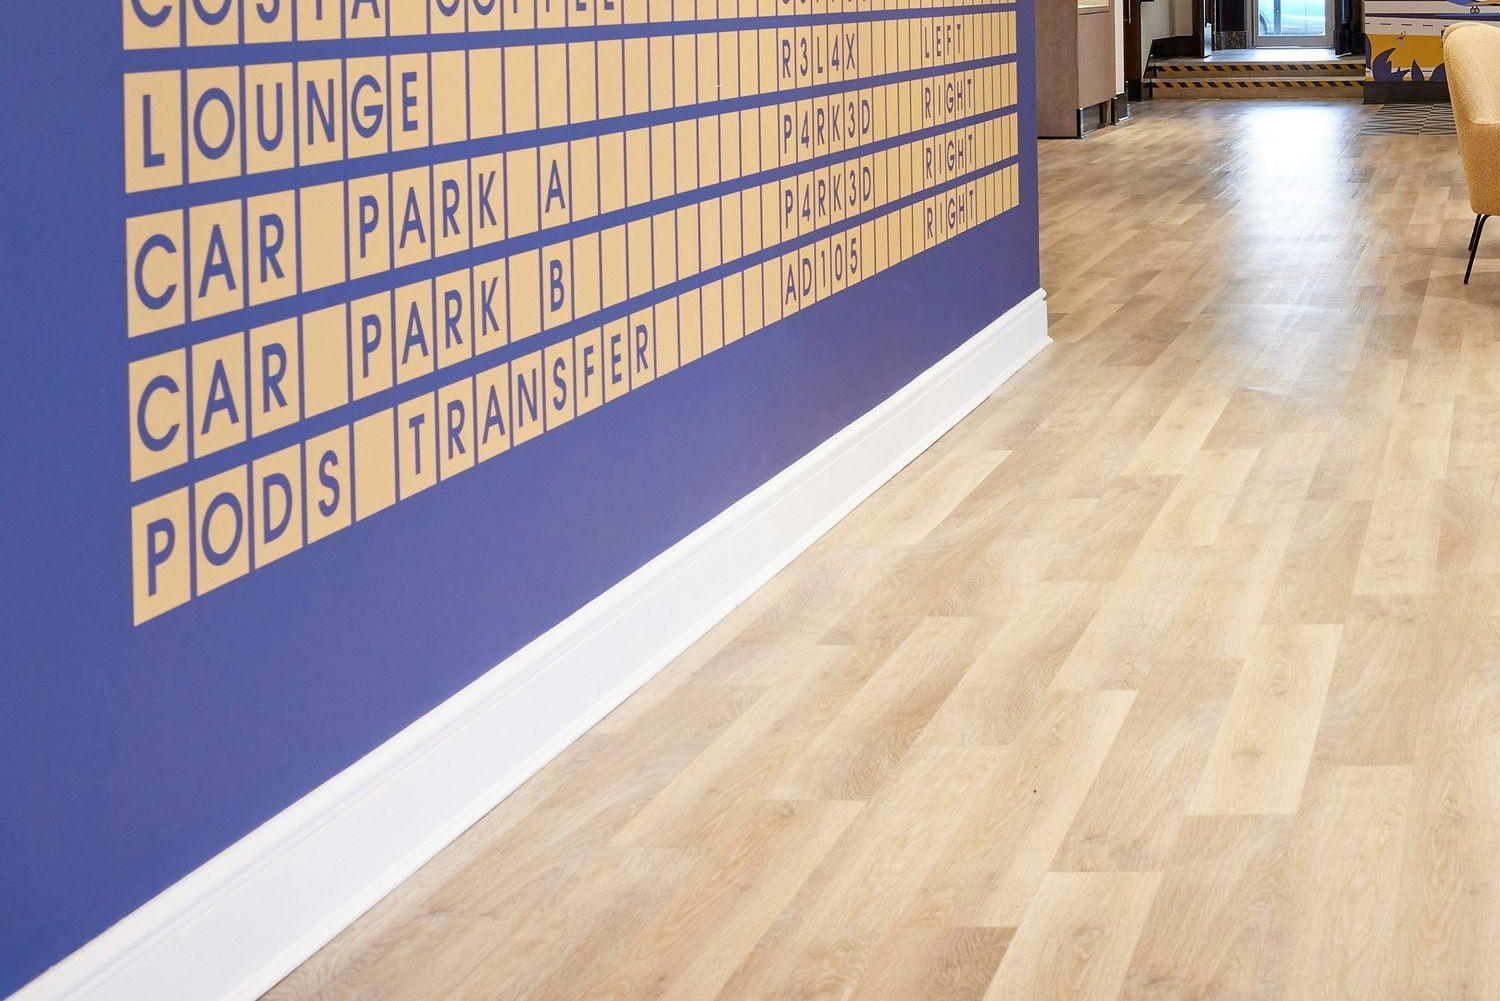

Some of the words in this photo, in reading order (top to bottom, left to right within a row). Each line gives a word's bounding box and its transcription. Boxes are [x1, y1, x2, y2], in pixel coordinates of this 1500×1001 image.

[133, 212, 285, 311] CAR
[359, 171, 497, 259] PARK
[544, 160, 566, 213] A
[784, 99, 871, 154] P4RK3D
[925, 78, 972, 119] RIGHT
[141, 71, 419, 168] LOUNGE
[782, 33, 856, 78] R3L4X
[925, 23, 962, 58] LEFT
[136, 342, 288, 453] CAR
[360, 276, 500, 379] PARK
[548, 259, 565, 312] B
[785, 166, 872, 229] P4RK3D
[926, 134, 973, 179] RIGHT
[145, 449, 341, 597] PODS
[407, 323, 650, 475] TRANSFER
[927, 189, 974, 240] RIGHT
